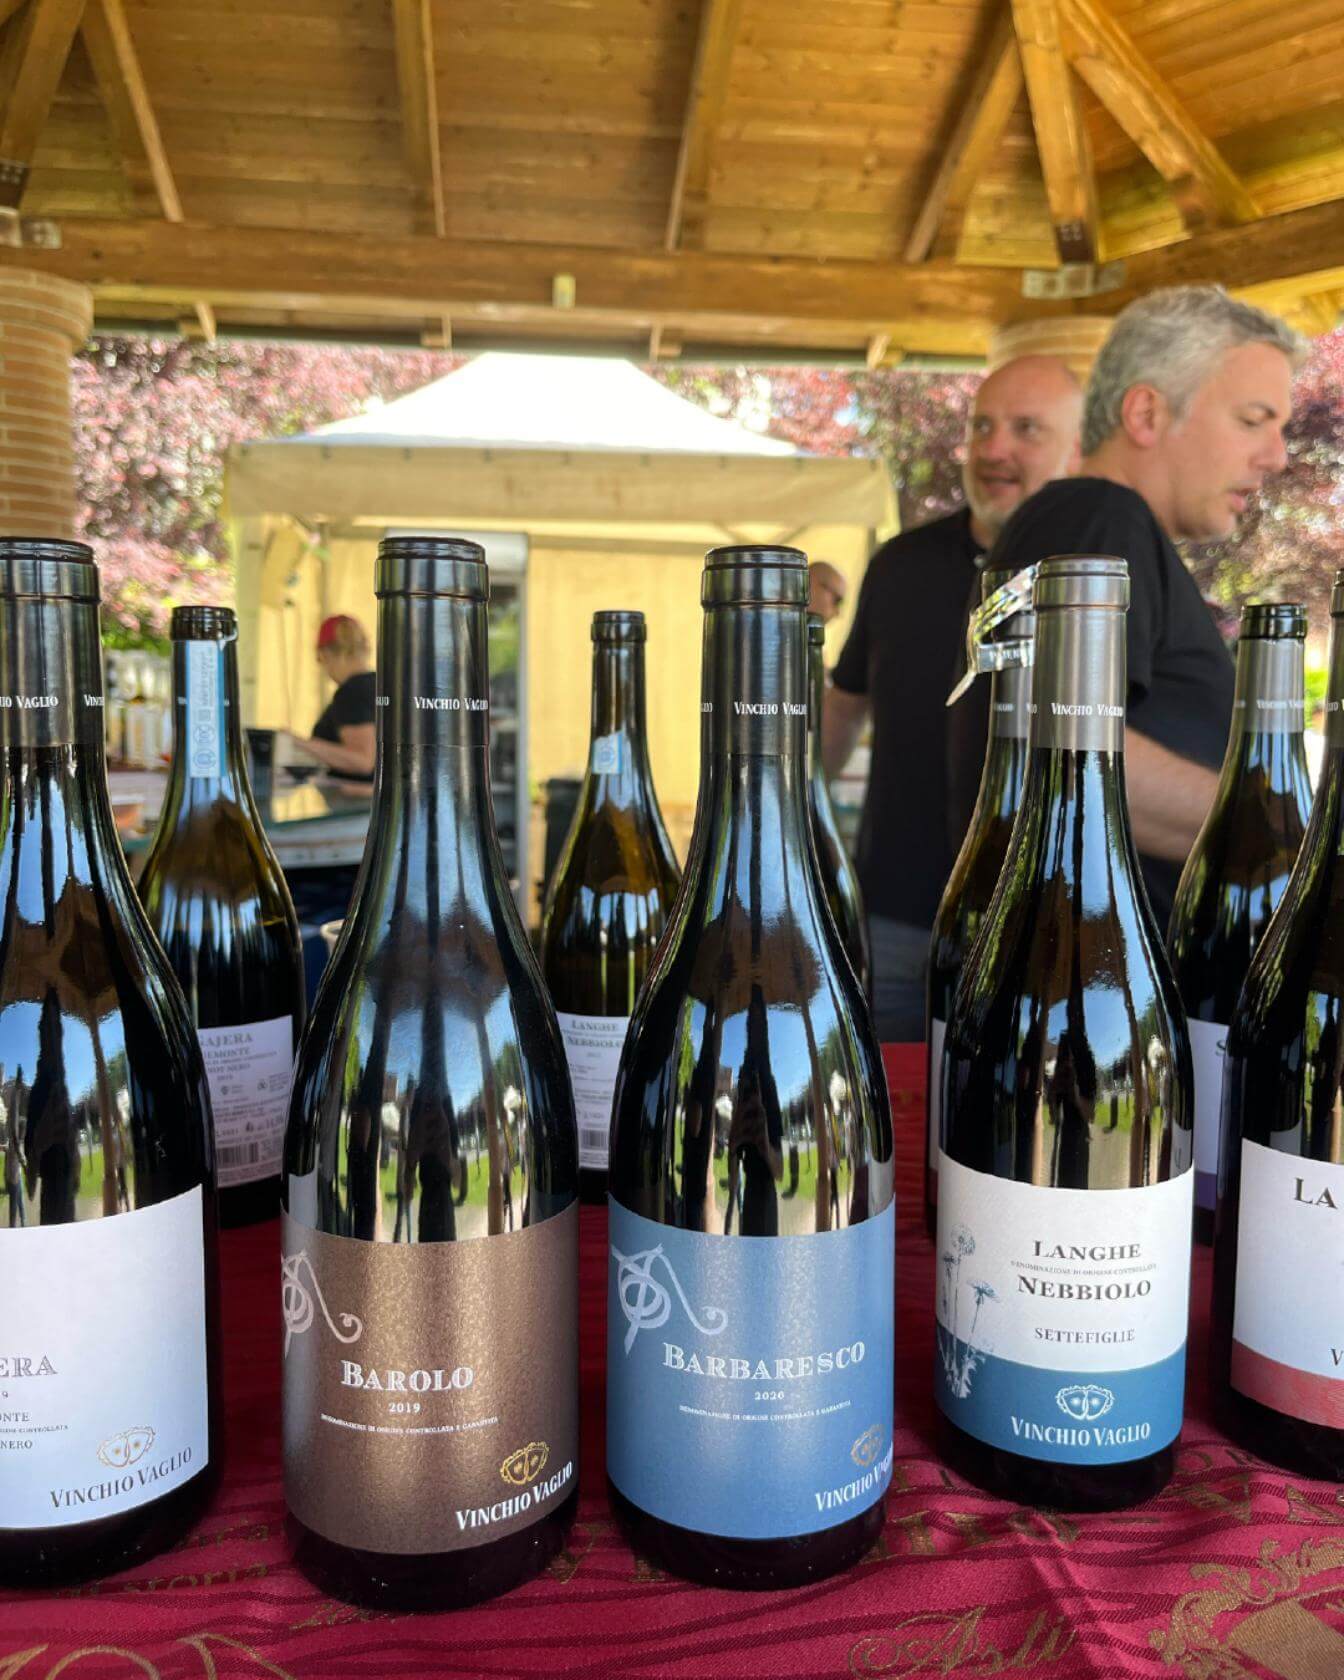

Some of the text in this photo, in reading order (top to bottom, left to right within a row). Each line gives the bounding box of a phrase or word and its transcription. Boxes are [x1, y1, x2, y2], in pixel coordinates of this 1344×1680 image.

[16, 695, 59, 709] VAGLIO
[414, 696, 460, 710] VINCHIO
[734, 701, 778, 715] VINCHIO
[1051, 702, 1092, 717] VINCHIO
[1033, 1240, 1141, 1261] LANGHE
[1017, 1274, 1151, 1301] NEBBIOLO
[1034, 1326, 1136, 1345] SETTEFIGLIE
[662, 1341, 866, 1380] BARBARESCO
[340, 1359, 475, 1392] BAROLO
[0, 1411, 31, 1422] NTE
[388, 1402, 421, 1414] 2019
[1011, 1415, 1151, 1447] VINCHIO VAGLIO
[50, 1446, 192, 1509] VINCHIO VAGLIO
[455, 1460, 573, 1531] VINCHIO VAGLIO
[815, 1472, 873, 1512] VINCHIO
